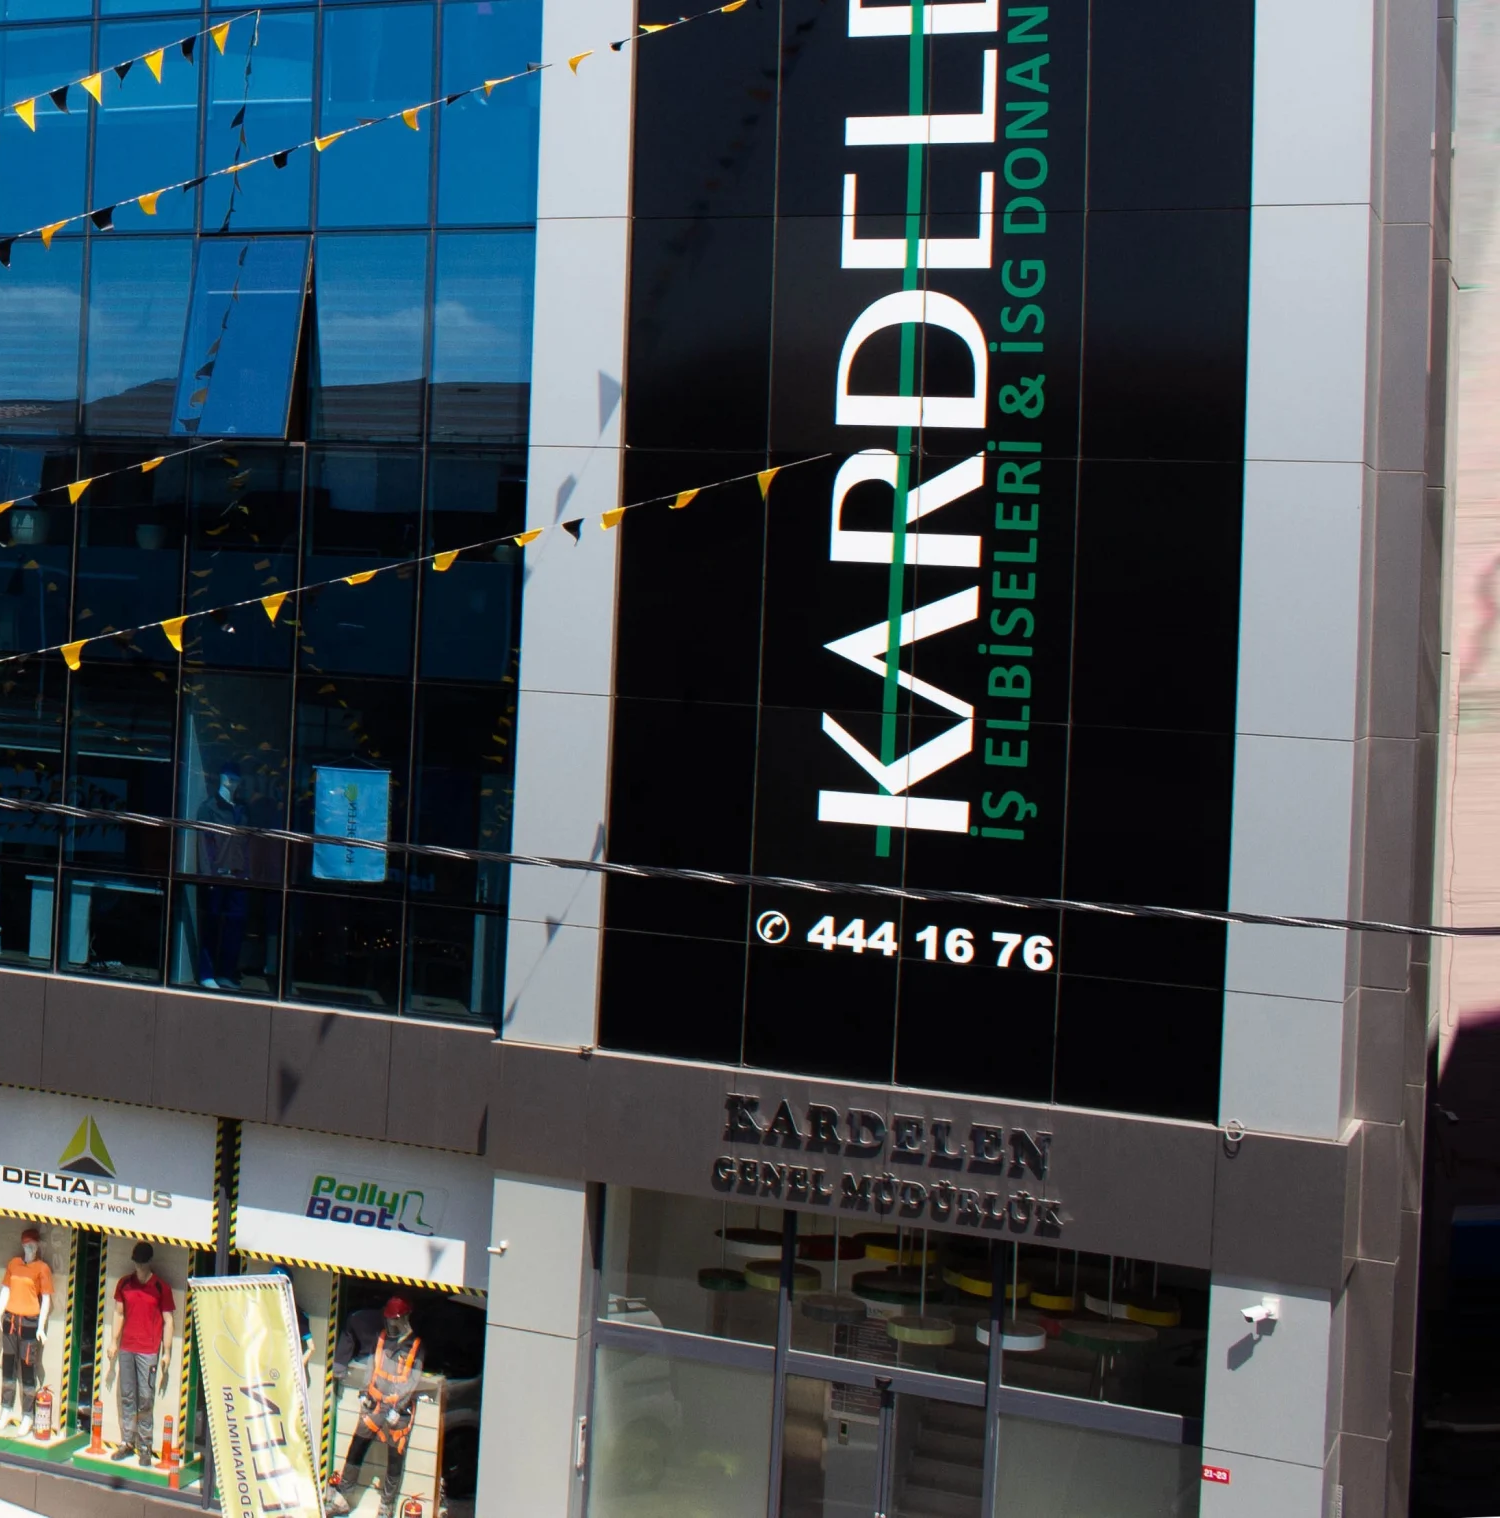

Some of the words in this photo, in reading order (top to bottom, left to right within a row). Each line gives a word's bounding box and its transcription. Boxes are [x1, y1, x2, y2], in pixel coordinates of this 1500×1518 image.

[989, 258, 1047, 354] İSG
[997, 373, 1046, 420] &
[978, 441, 1042, 768] ELBİSELERİ
[970, 788, 1038, 842] İŞ
[806, 914, 898, 957] 444
[916, 925, 975, 964] 16
[991, 930, 1054, 972] 76
[724, 1092, 1054, 1181] KARDELEN
[3, 1166, 173, 1209] DELTAPLUS
[28, 1190, 54, 1203] YOUR
[56, 1195, 91, 1209] SAFETY
[94, 1202, 105, 1211] AT
[107, 1203, 136, 1216] WORK
[306, 1196, 395, 1230] Boot
[311, 1175, 399, 1214] Polly
[713, 1156, 833, 1203] GENEL
[841, 1172, 1065, 1237] MÜDÜRLÜK
